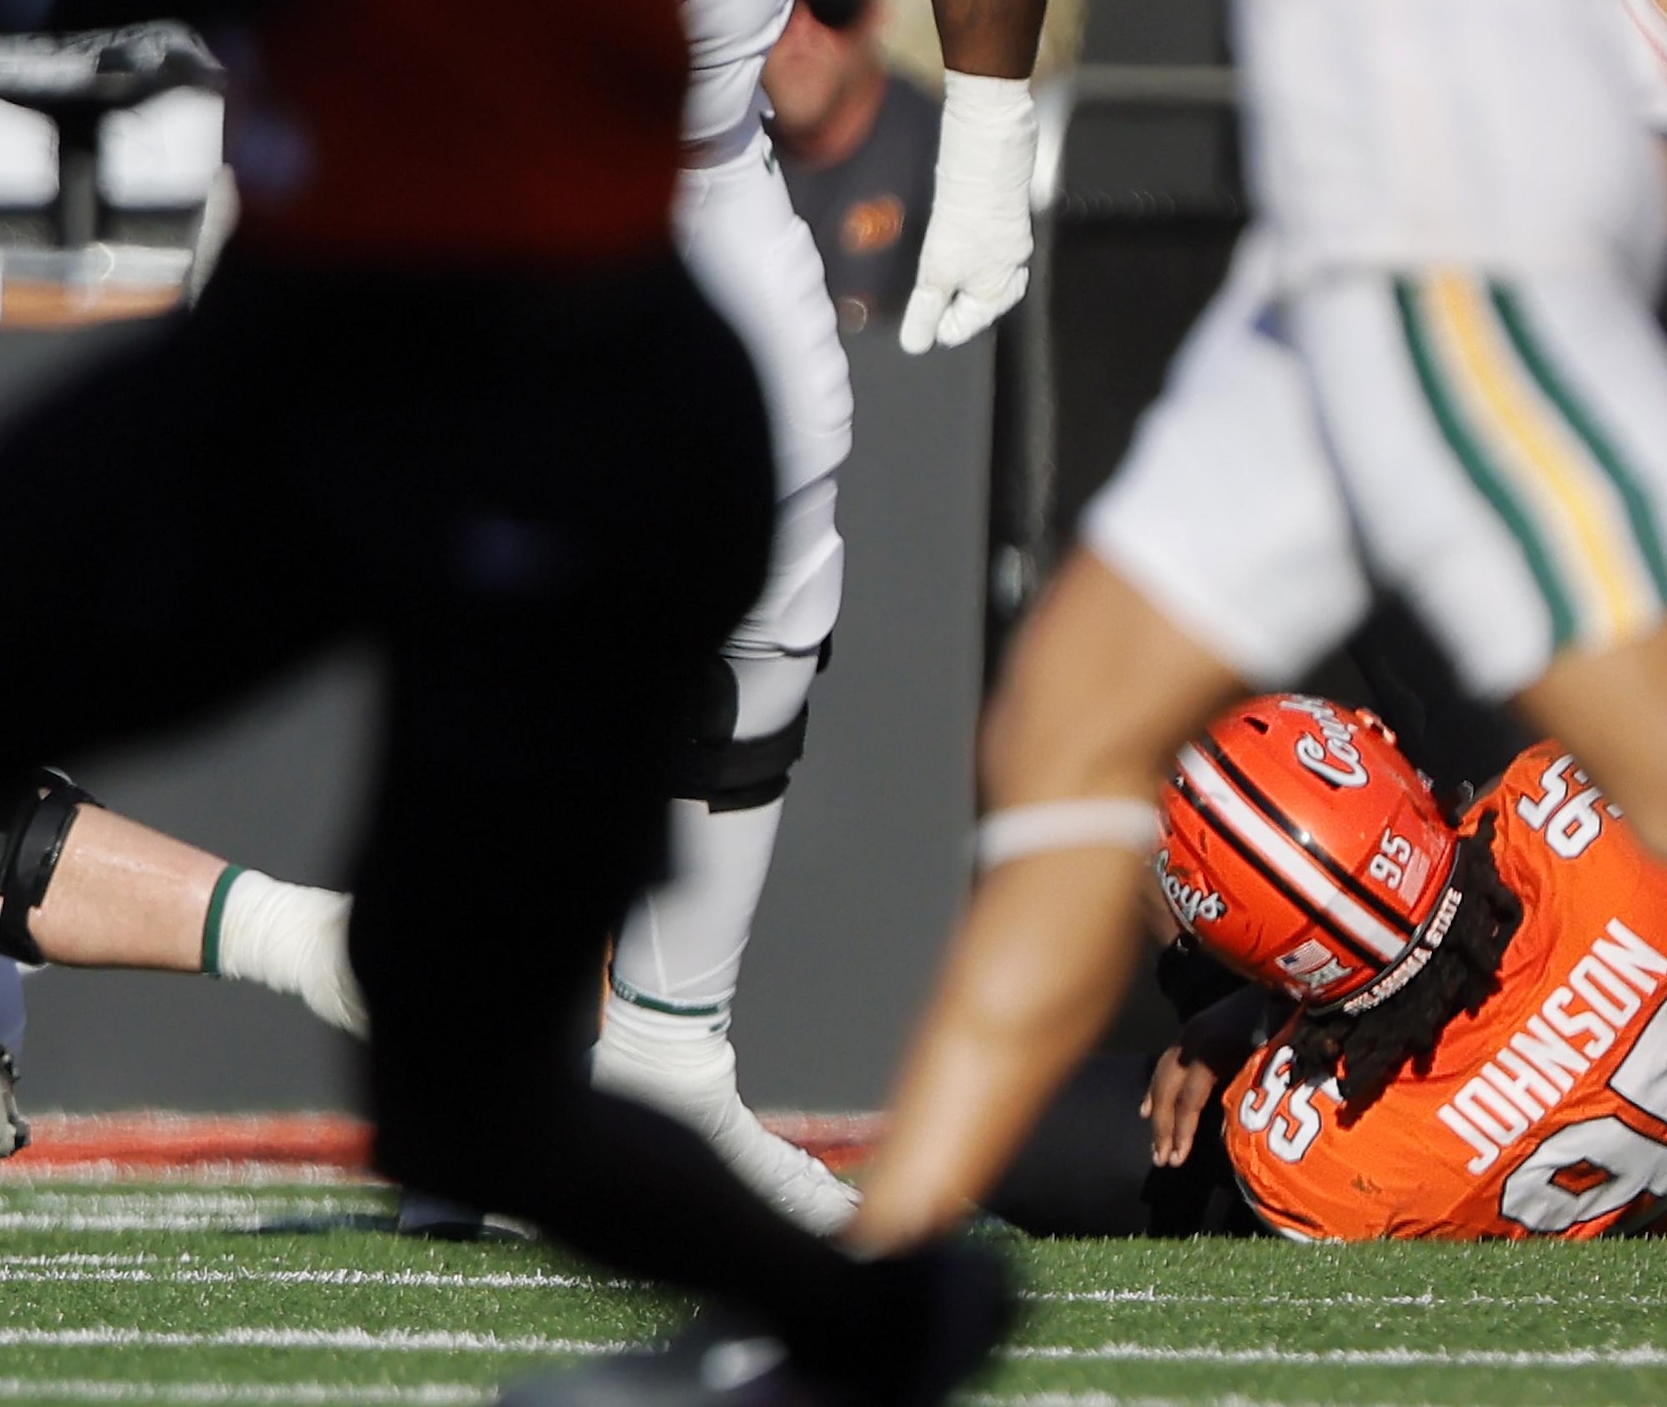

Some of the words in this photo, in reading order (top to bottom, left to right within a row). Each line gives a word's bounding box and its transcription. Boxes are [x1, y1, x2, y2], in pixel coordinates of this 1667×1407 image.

[1370, 827, 1413, 891] 95
[1425, 886, 1463, 949] STATE
[1435, 916, 1667, 1176] JOHNSON
